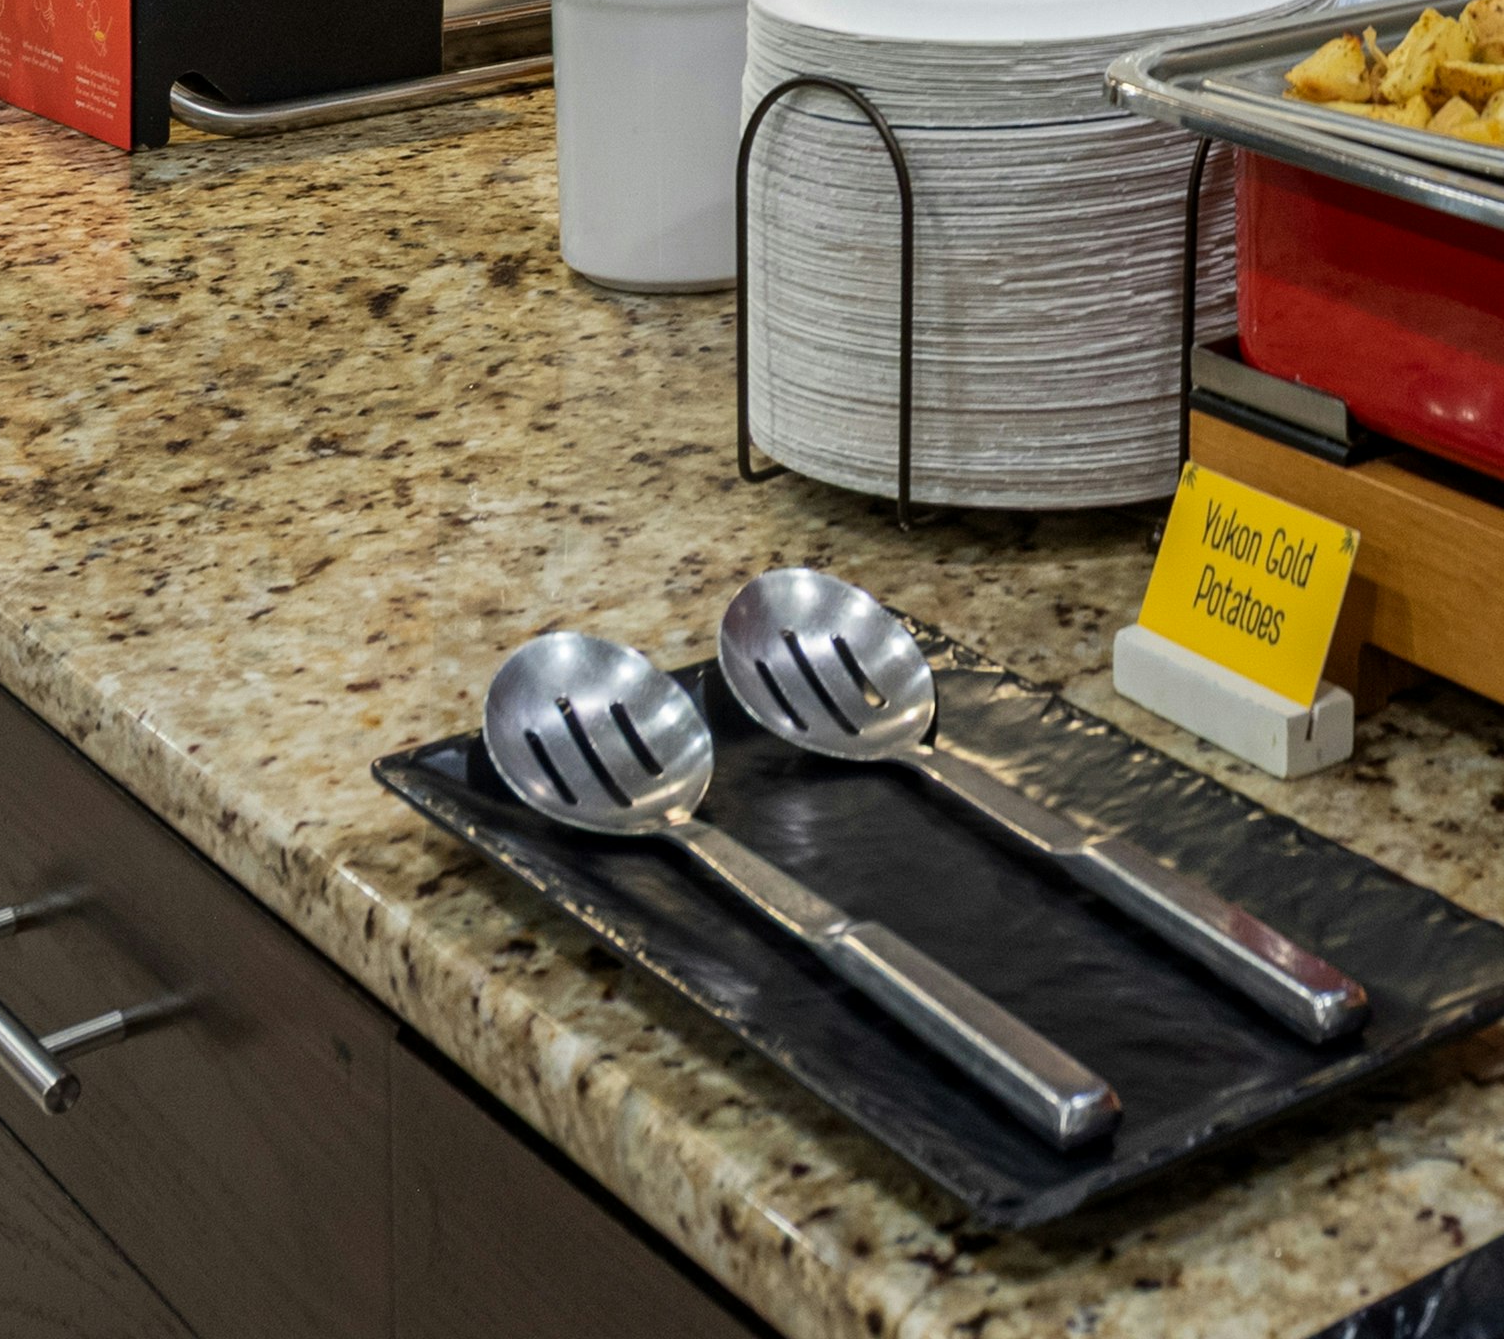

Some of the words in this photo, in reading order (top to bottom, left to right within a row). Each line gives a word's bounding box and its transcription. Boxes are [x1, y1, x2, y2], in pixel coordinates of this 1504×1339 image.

[1201, 498, 1263, 567] Yukon
[1265, 527, 1318, 589] Gold
[1193, 563, 1285, 646] Potatoes
